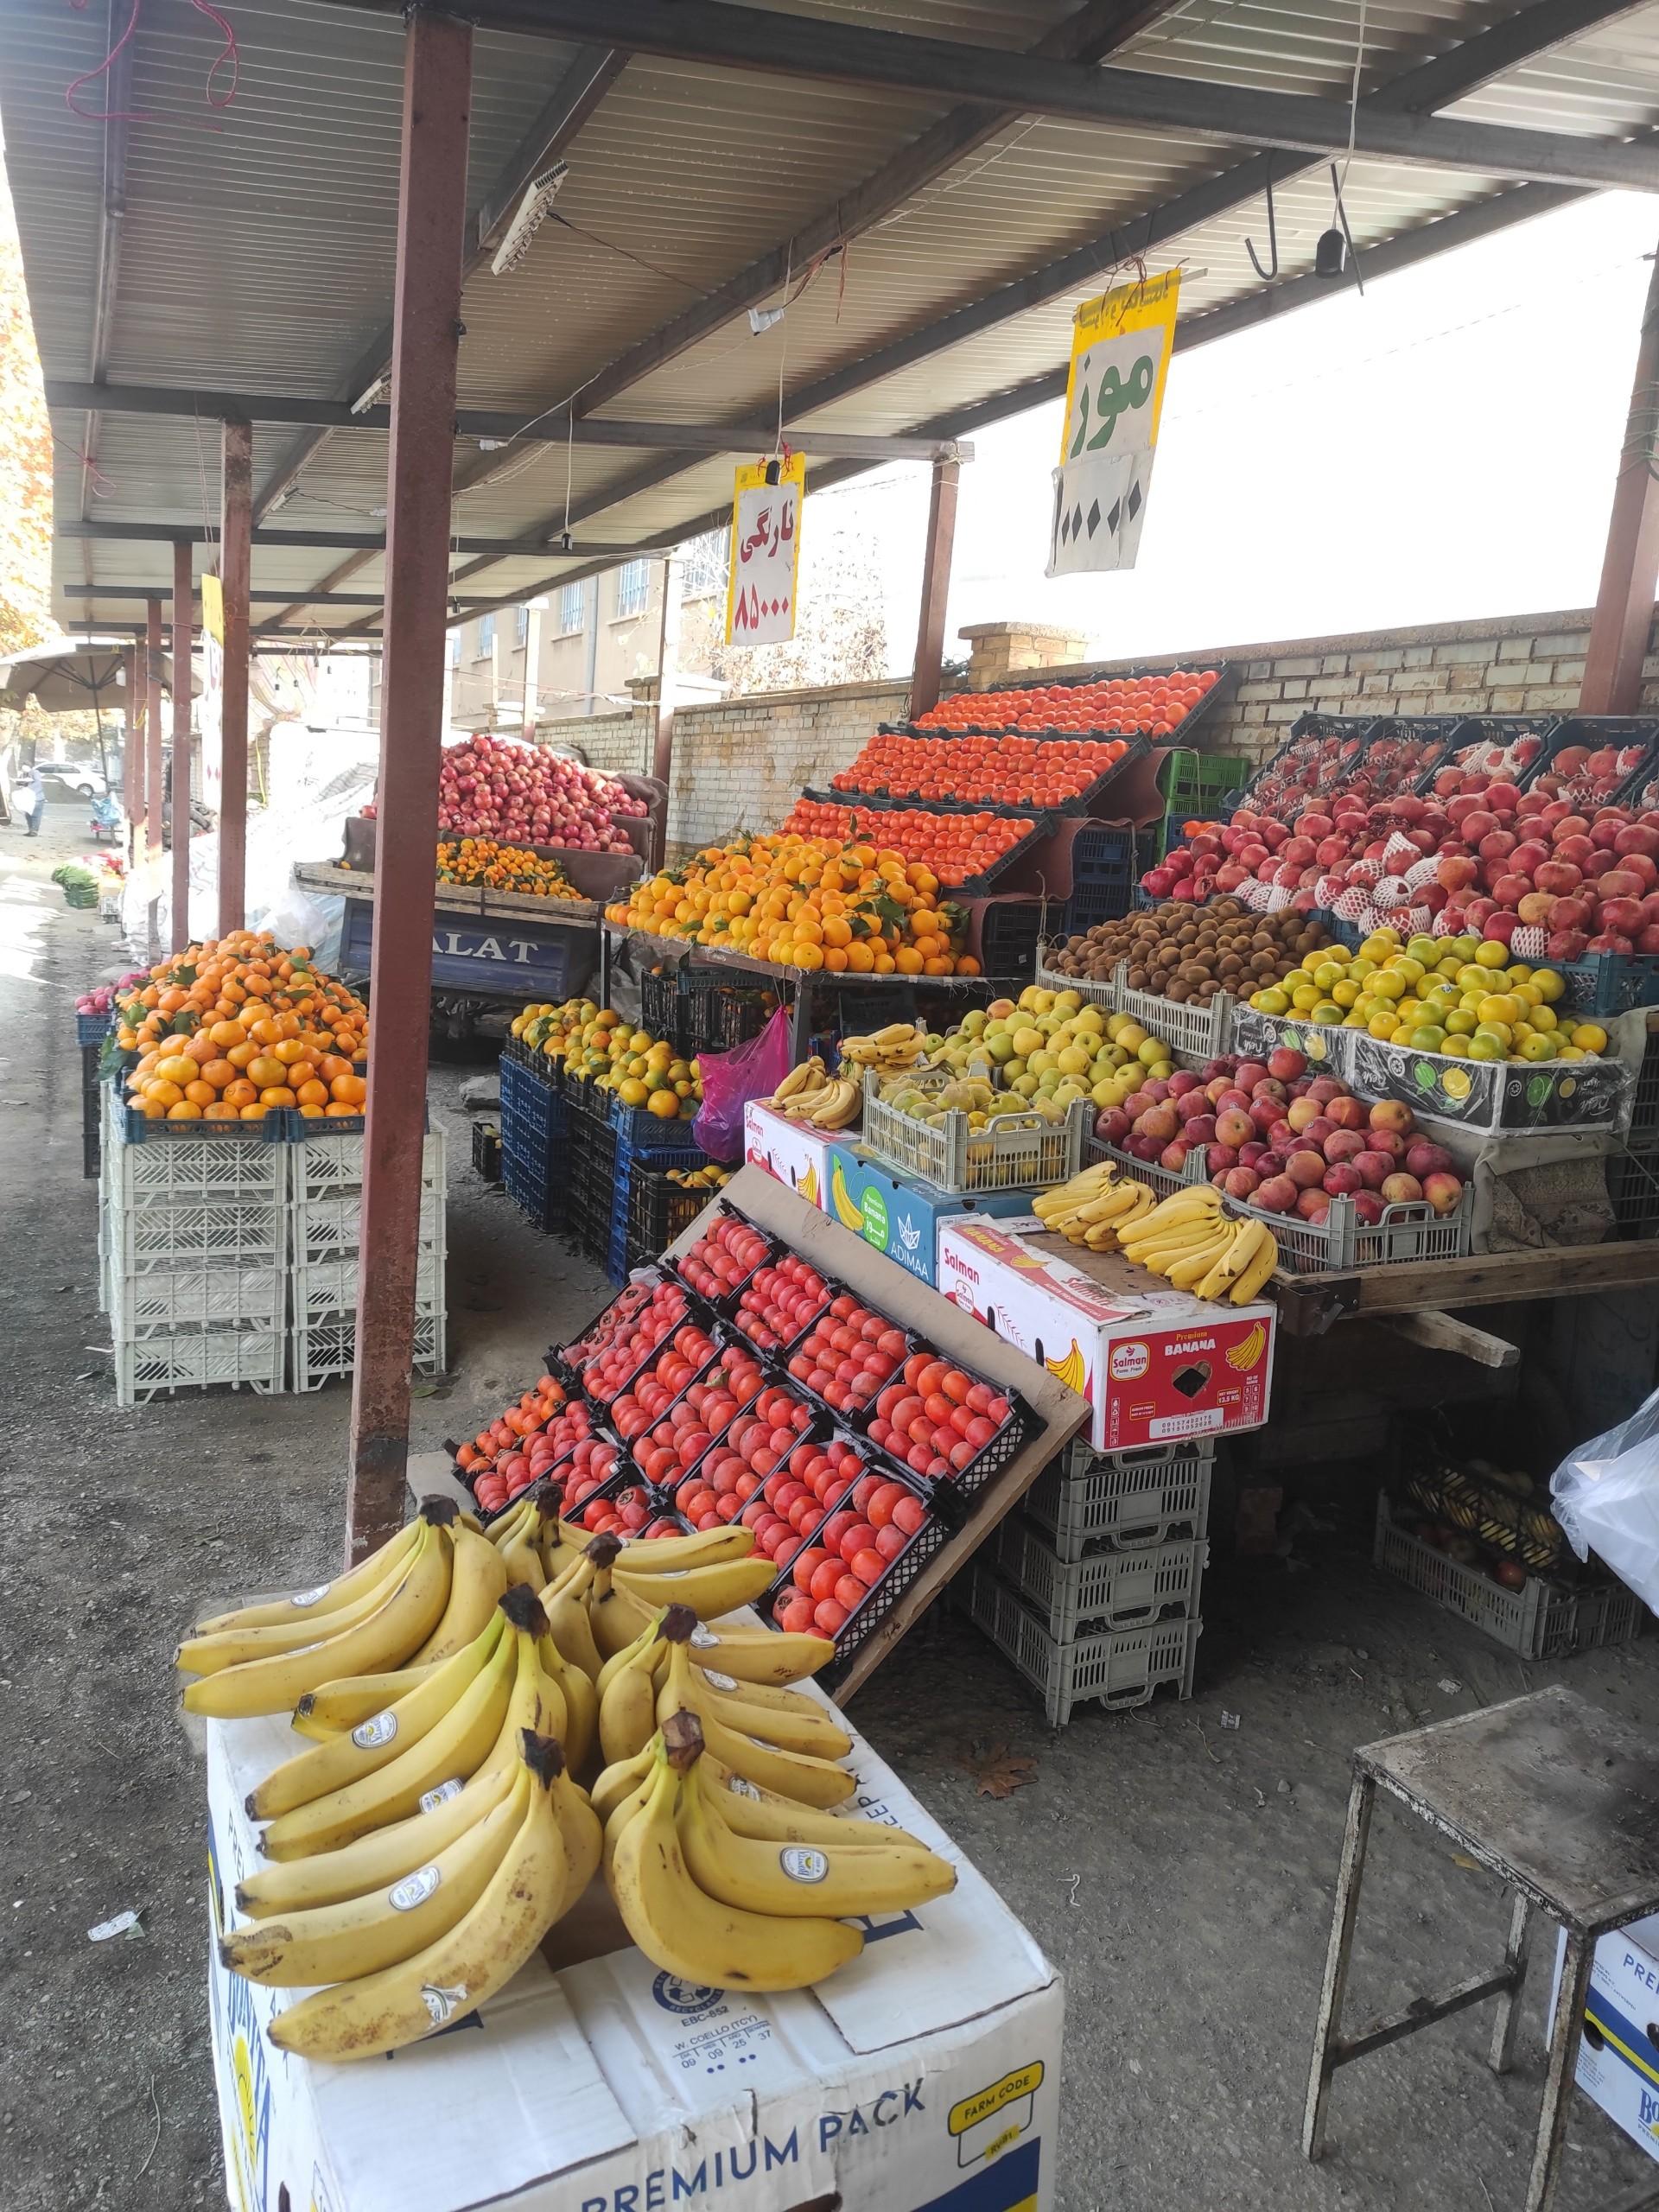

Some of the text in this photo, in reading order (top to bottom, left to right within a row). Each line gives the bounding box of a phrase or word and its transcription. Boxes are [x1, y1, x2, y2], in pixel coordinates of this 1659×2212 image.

[1071, 353, 1154, 459] موز
[741, 499, 794, 563] نارنگی
[735, 583, 789, 630] ۸۵۰۰۰
[864, 1202, 885, 1224] Banana
[891, 1242, 929, 1281] ADIMAA
[944, 1247, 980, 1285] Salman
[1165, 1338, 1216, 1356] BANANA
[1176, 1332, 1207, 1341] Premium
[1113, 1357, 1147, 1369] Salman
[681, 2005, 729, 2027] EBC-852
[690, 2024, 729, 2045] COELLO
[731, 2014, 758, 2031] (TCY)
[681, 2030, 772, 2069] 09 09 25 37
[820, 2077, 925, 2153] PACK
[963, 2075, 1030, 2120] FARM CODE
